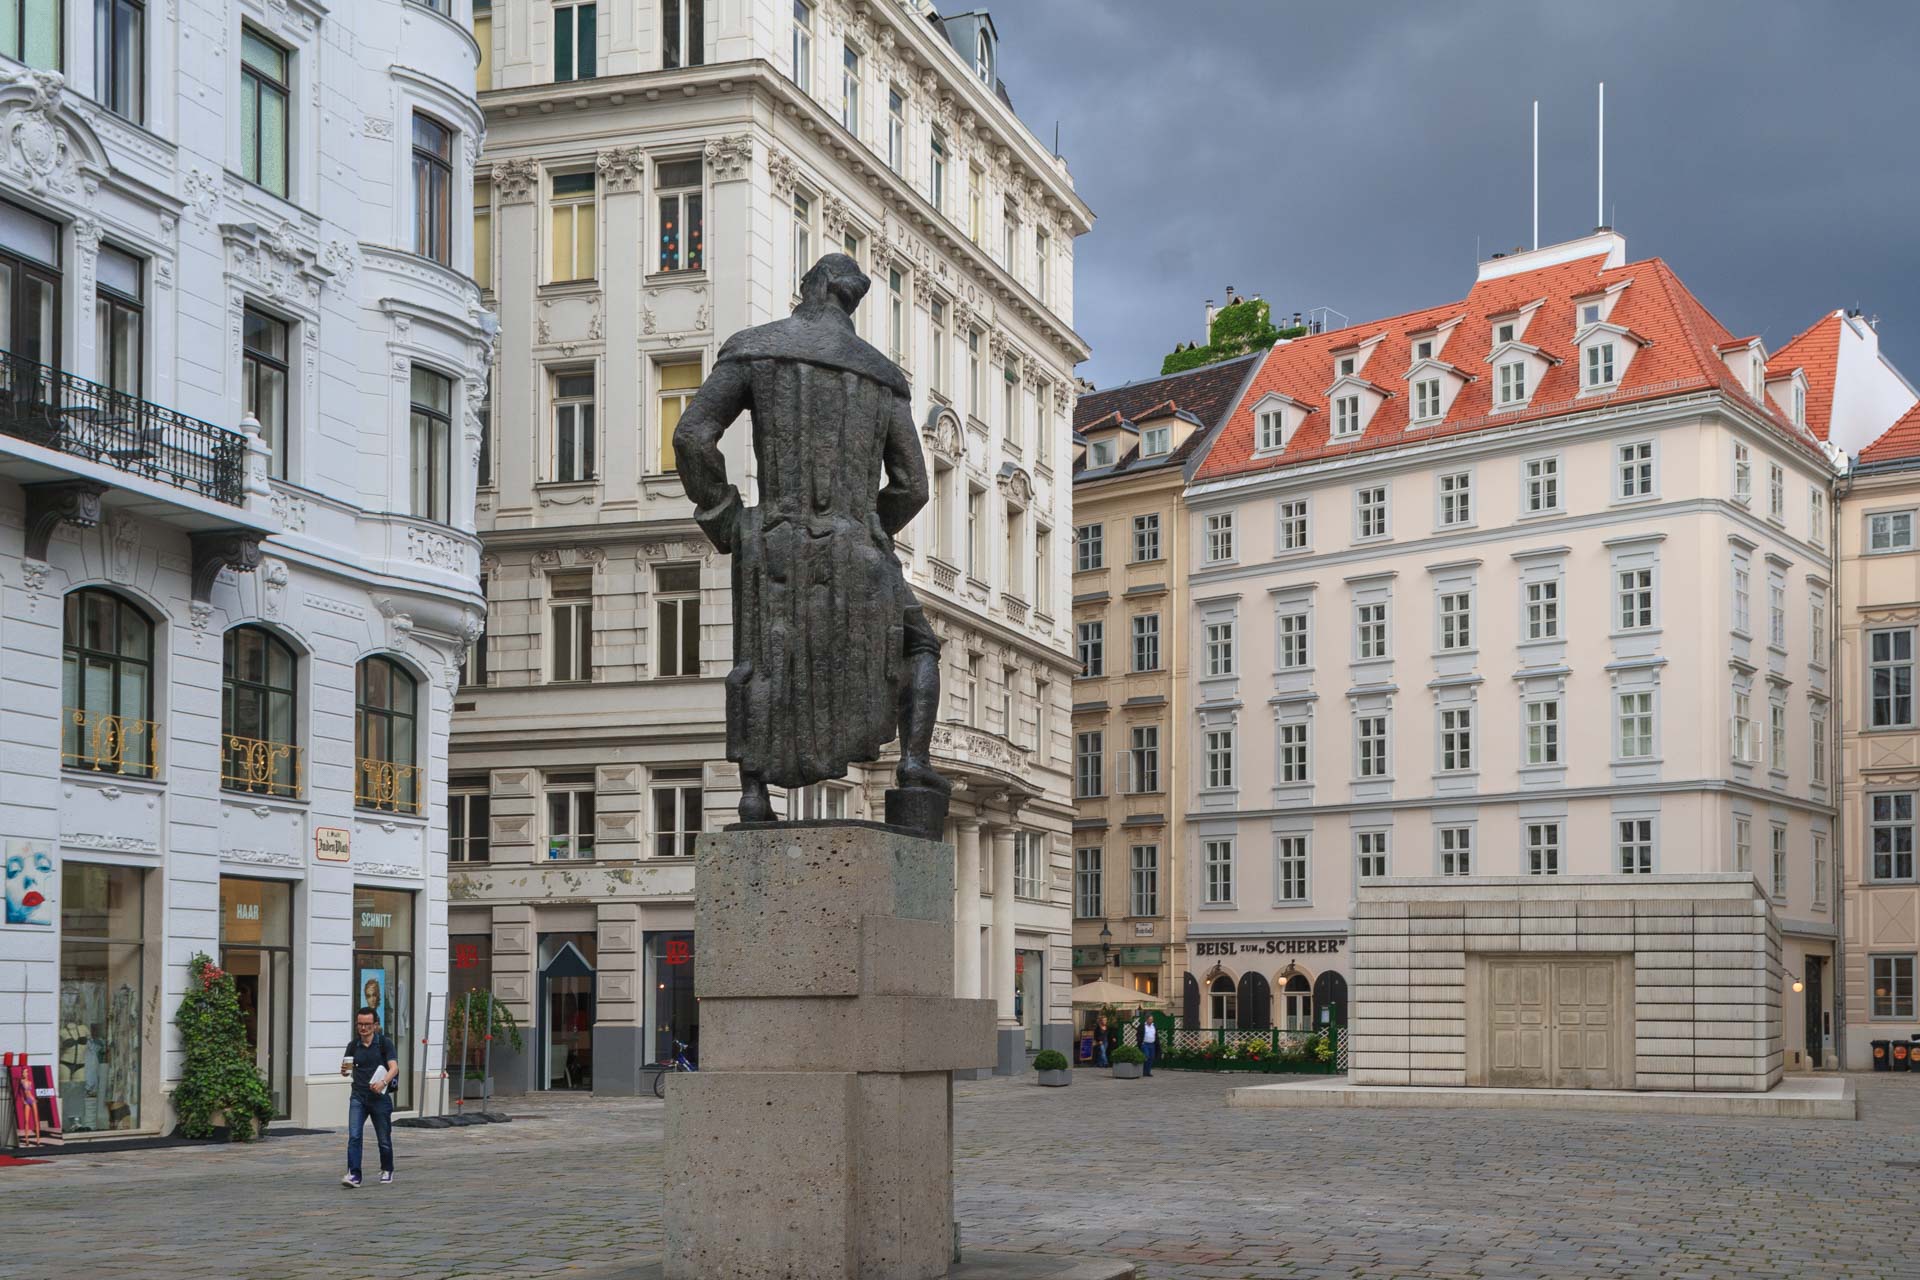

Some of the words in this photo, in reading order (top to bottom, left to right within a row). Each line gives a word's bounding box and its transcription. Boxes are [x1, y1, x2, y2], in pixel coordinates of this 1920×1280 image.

[236, 904, 259, 920] HAAR
[361, 912, 392, 928] SCHNITT
[1196, 942, 1237, 956] BEISL
